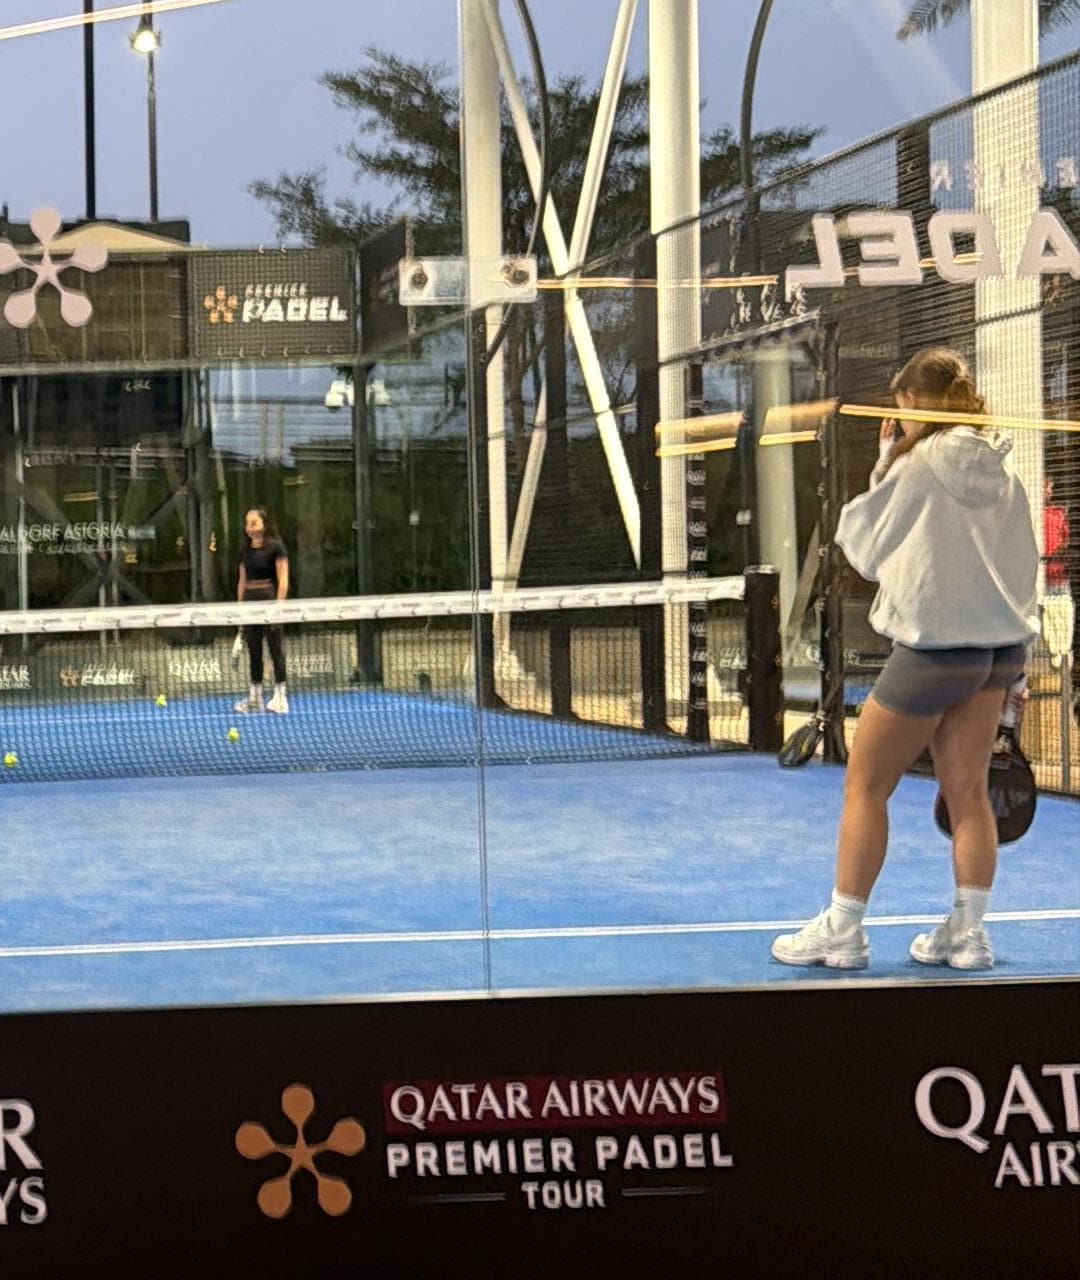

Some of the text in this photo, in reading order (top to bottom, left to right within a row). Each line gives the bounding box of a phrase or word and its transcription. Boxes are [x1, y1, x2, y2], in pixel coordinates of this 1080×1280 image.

[242, 296, 348, 323] PADEL
[389, 1075, 720, 1129] QATAR AIRWAYS
[386, 1132, 735, 1179] PREMIER PADEL
[994, 1140, 1080, 1189] AIR
[520, 1178, 607, 1211] TOUR
